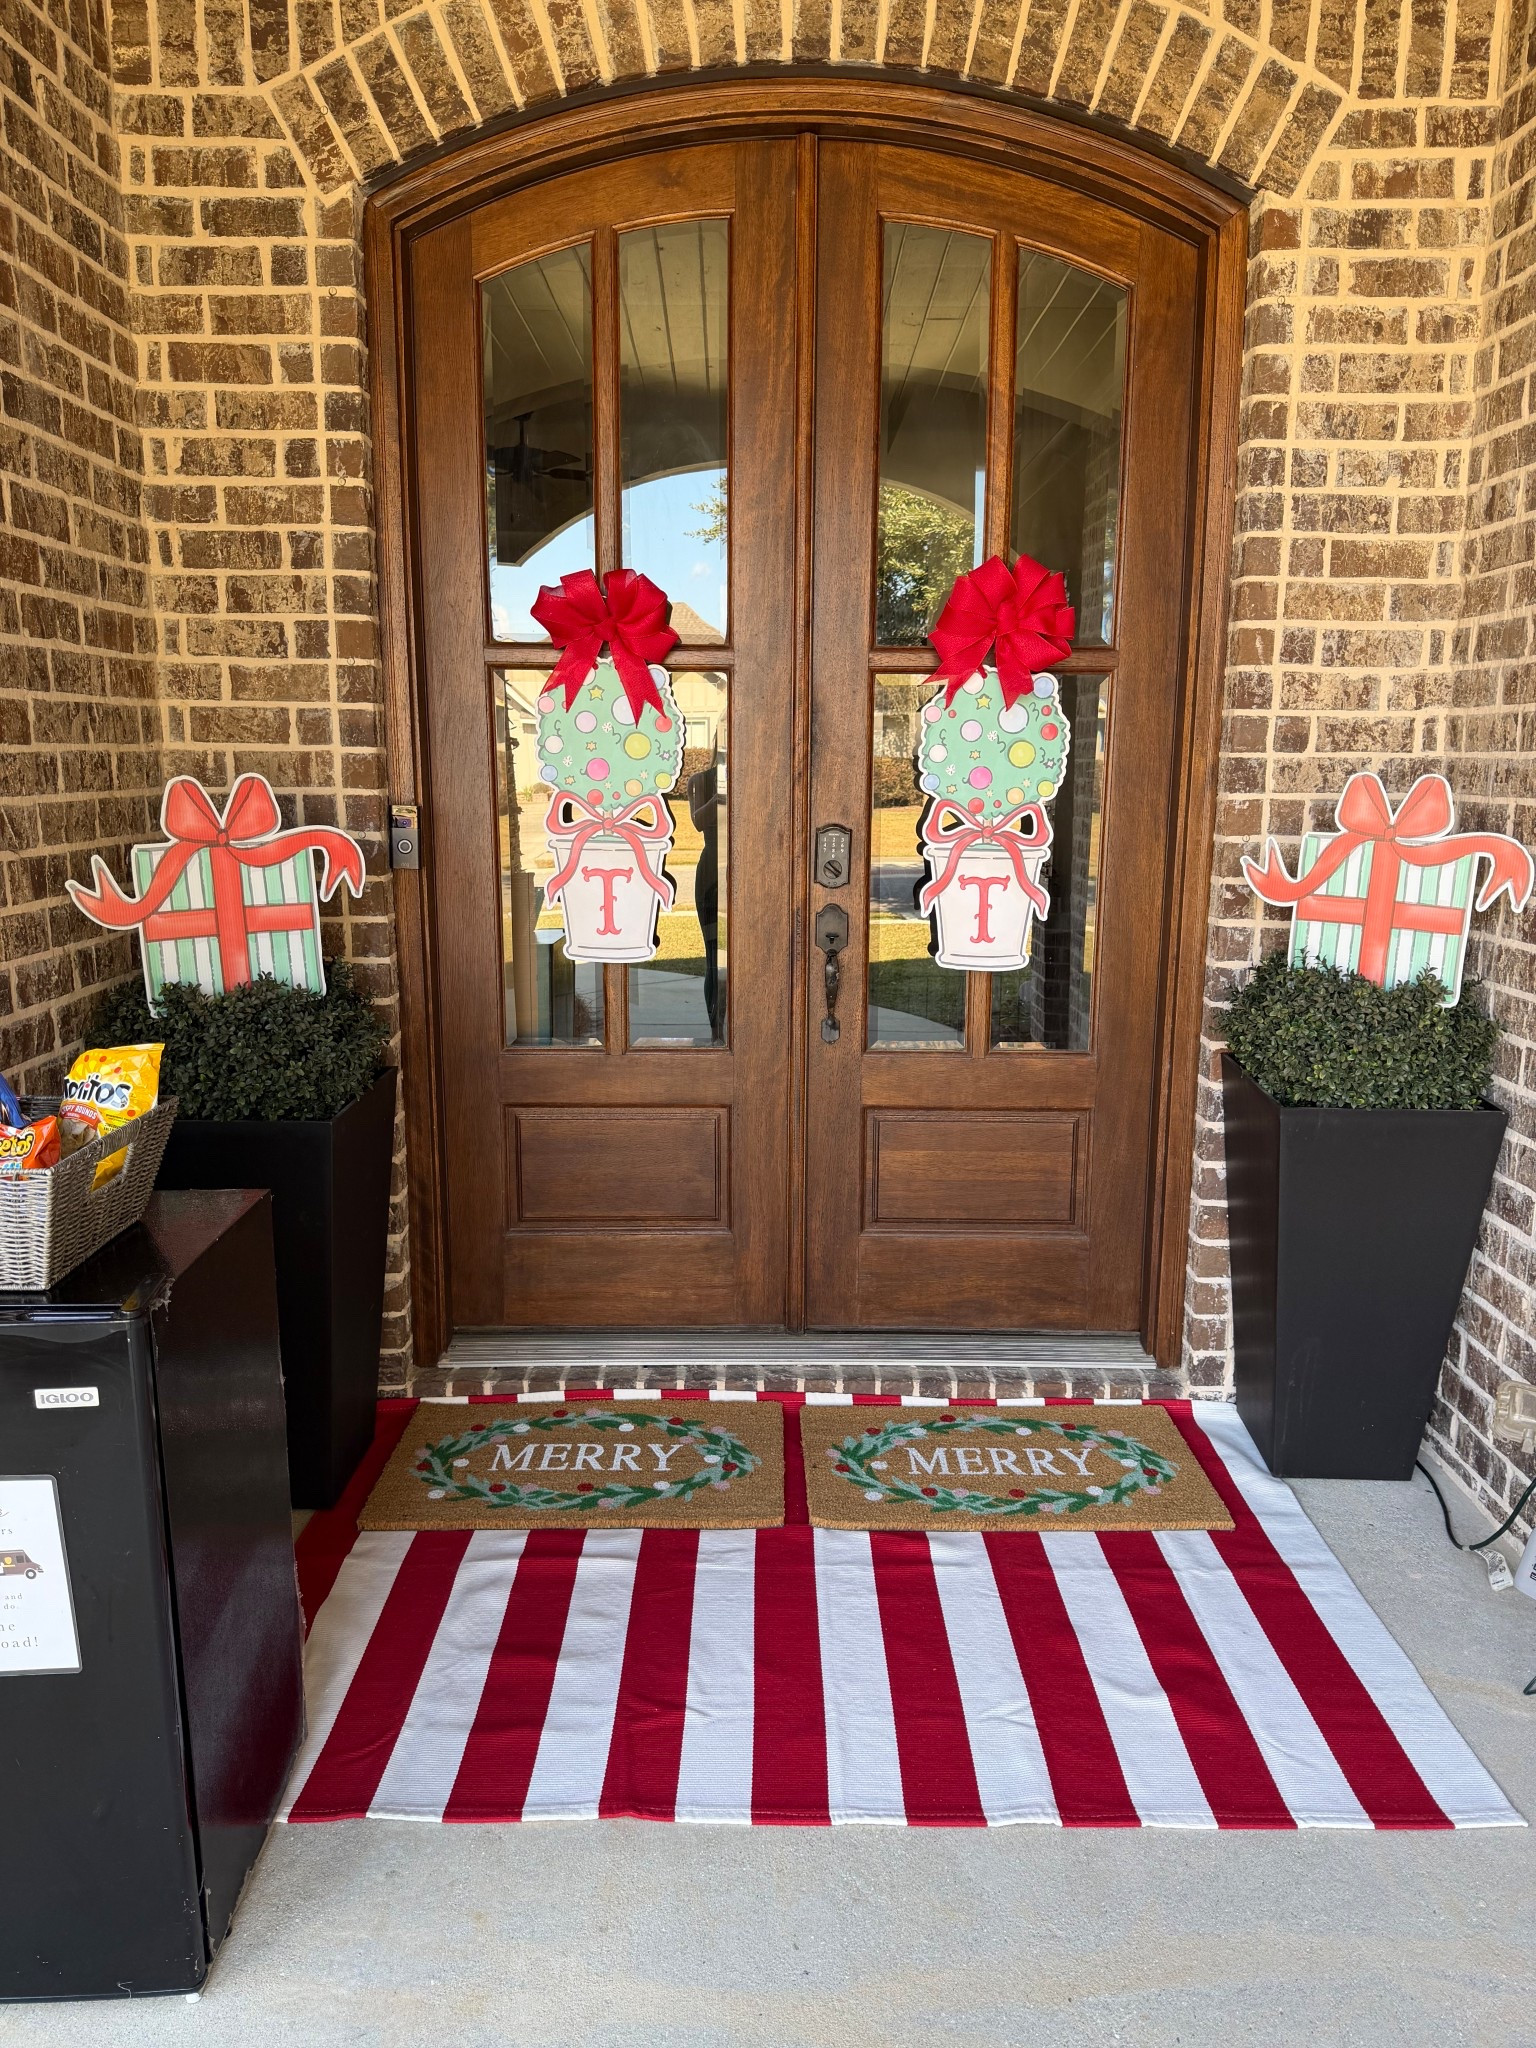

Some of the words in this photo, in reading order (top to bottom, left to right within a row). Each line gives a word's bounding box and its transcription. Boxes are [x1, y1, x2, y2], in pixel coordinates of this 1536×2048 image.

[581, 866, 634, 936] T
[958, 874, 1012, 944] T
[0, 1135, 34, 1157] etos
[40, 1392, 94, 1405] IGLOO
[487, 1443, 683, 1471] MERRY
[904, 1447, 1095, 1476] MERRY
[4, 1592, 23, 1600] and
[0, 1636, 39, 1649] oad!
